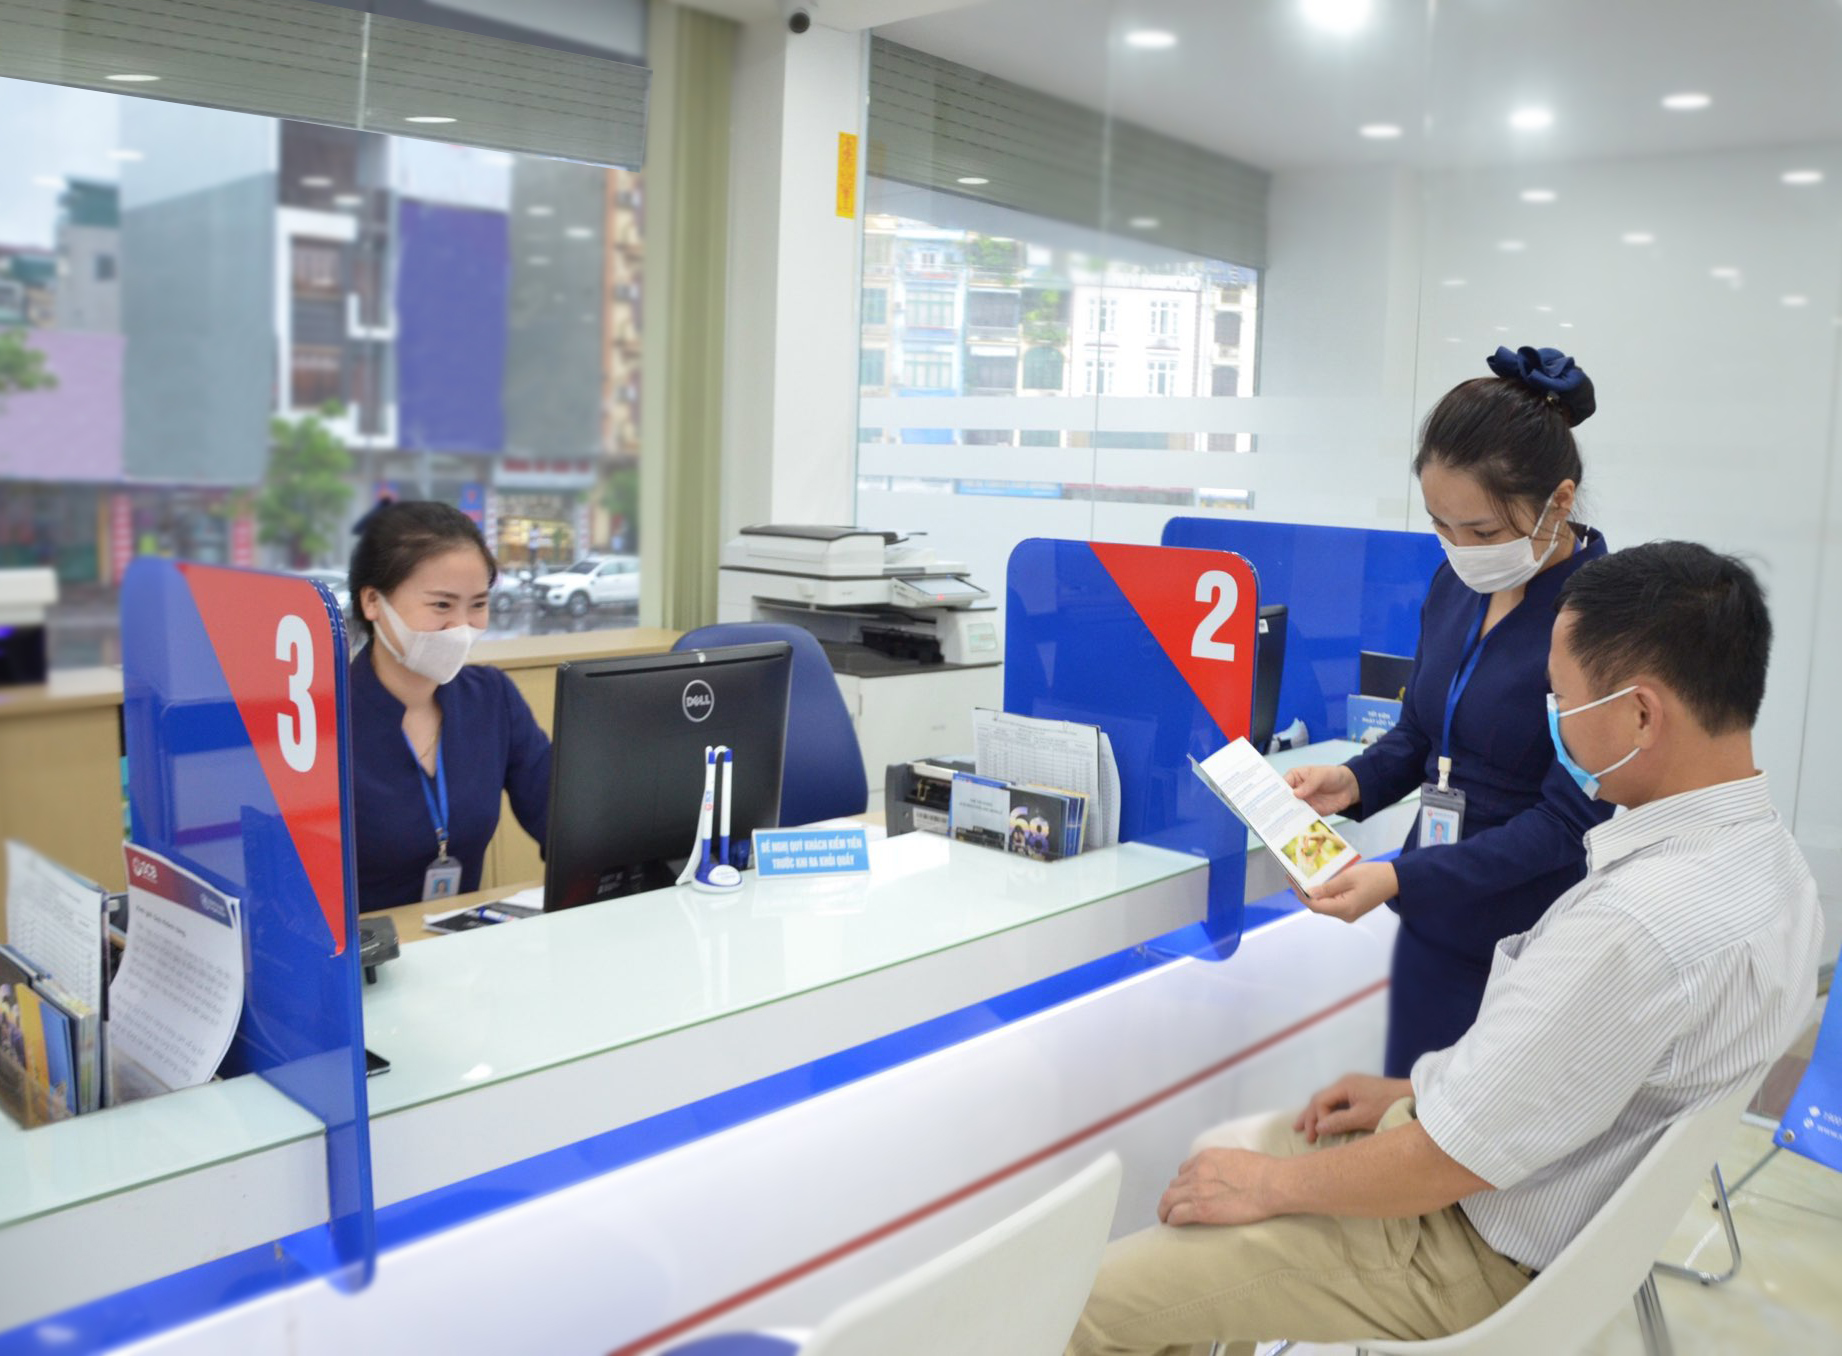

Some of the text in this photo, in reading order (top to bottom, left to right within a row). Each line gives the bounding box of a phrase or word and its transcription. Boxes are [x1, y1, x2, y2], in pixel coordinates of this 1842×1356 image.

[1191, 570, 1238, 662] 2
[275, 614, 317, 773] 3
[686, 694, 711, 707] DELL
